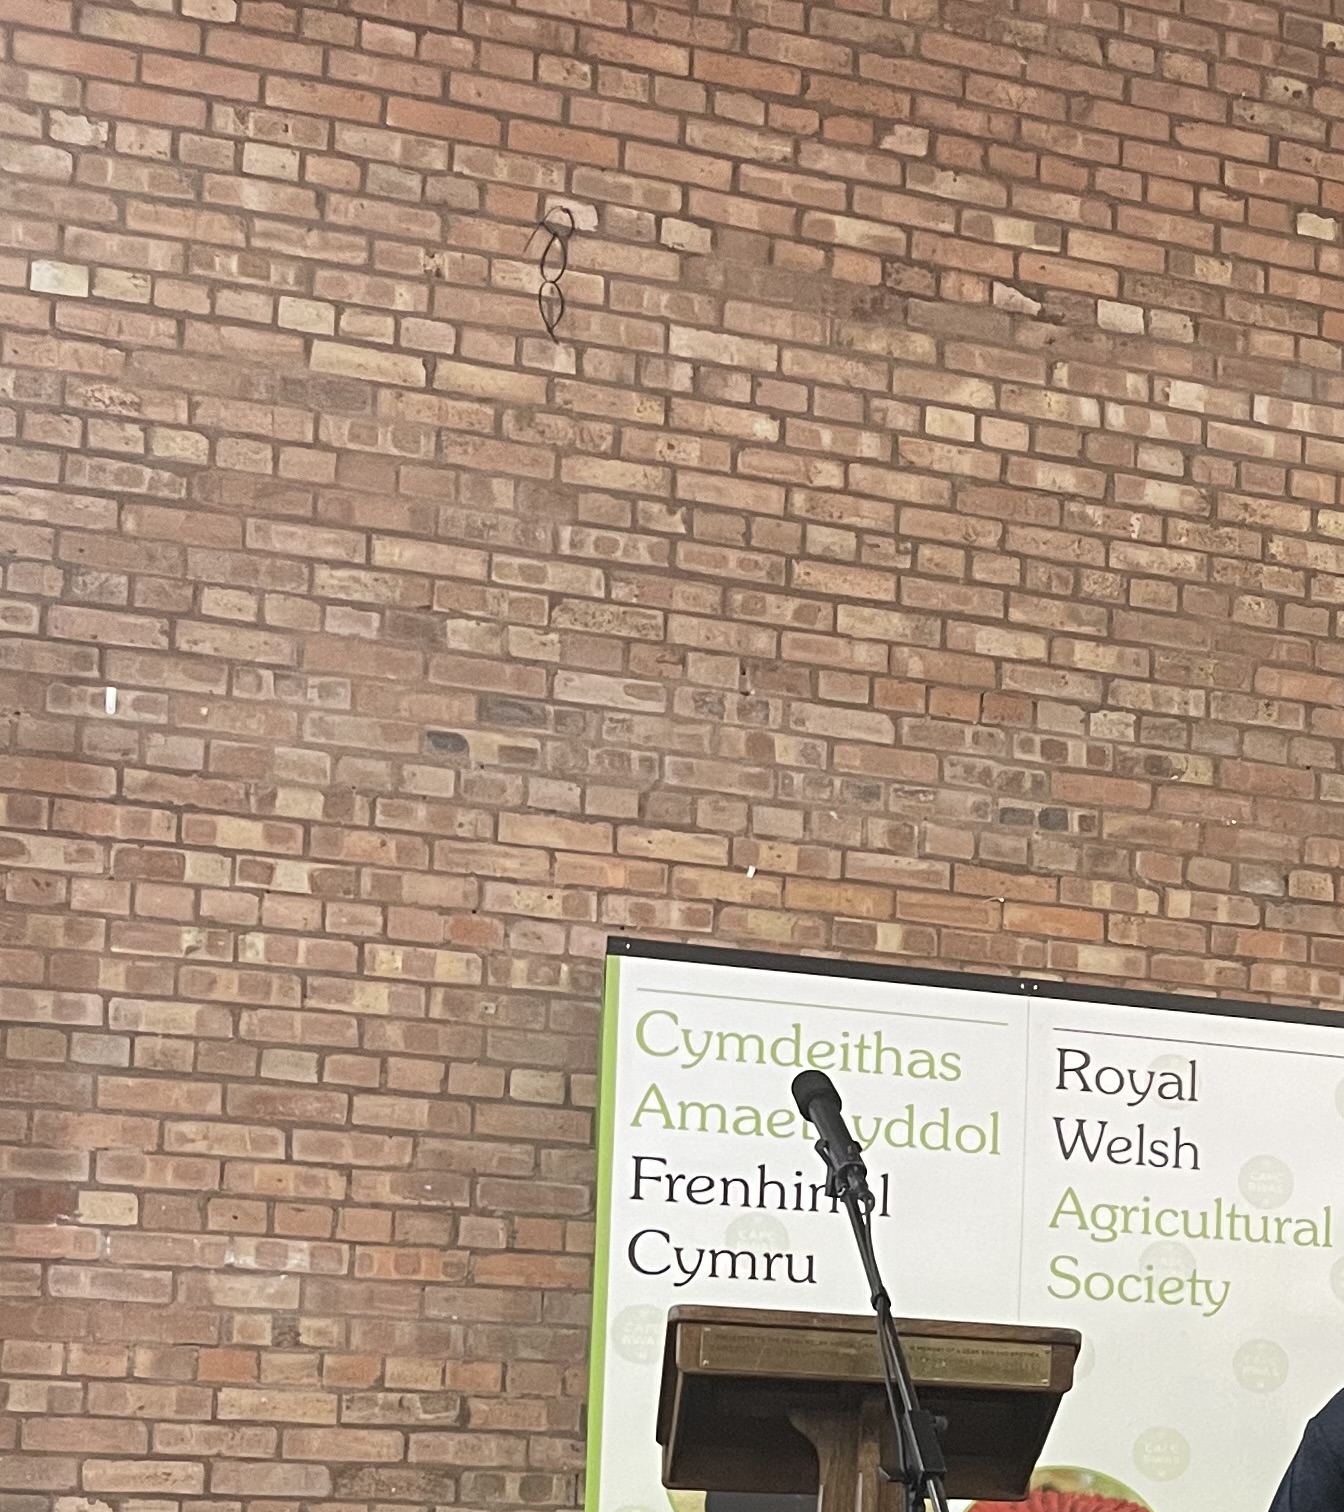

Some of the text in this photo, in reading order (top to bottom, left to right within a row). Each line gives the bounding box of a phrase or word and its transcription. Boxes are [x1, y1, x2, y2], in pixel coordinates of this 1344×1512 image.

[635, 1009, 963, 1082] Cymdeithas
[1055, 1047, 1199, 1107] Royal
[630, 1082, 1001, 1156] Amaeyddol
[1052, 1116, 1201, 1171] Welsh
[628, 1155, 892, 1218] Frenhinl
[1048, 1186, 1333, 1248] Agricultural
[627, 1228, 818, 1288] Cymru
[1047, 1255, 1231, 1318] Society
